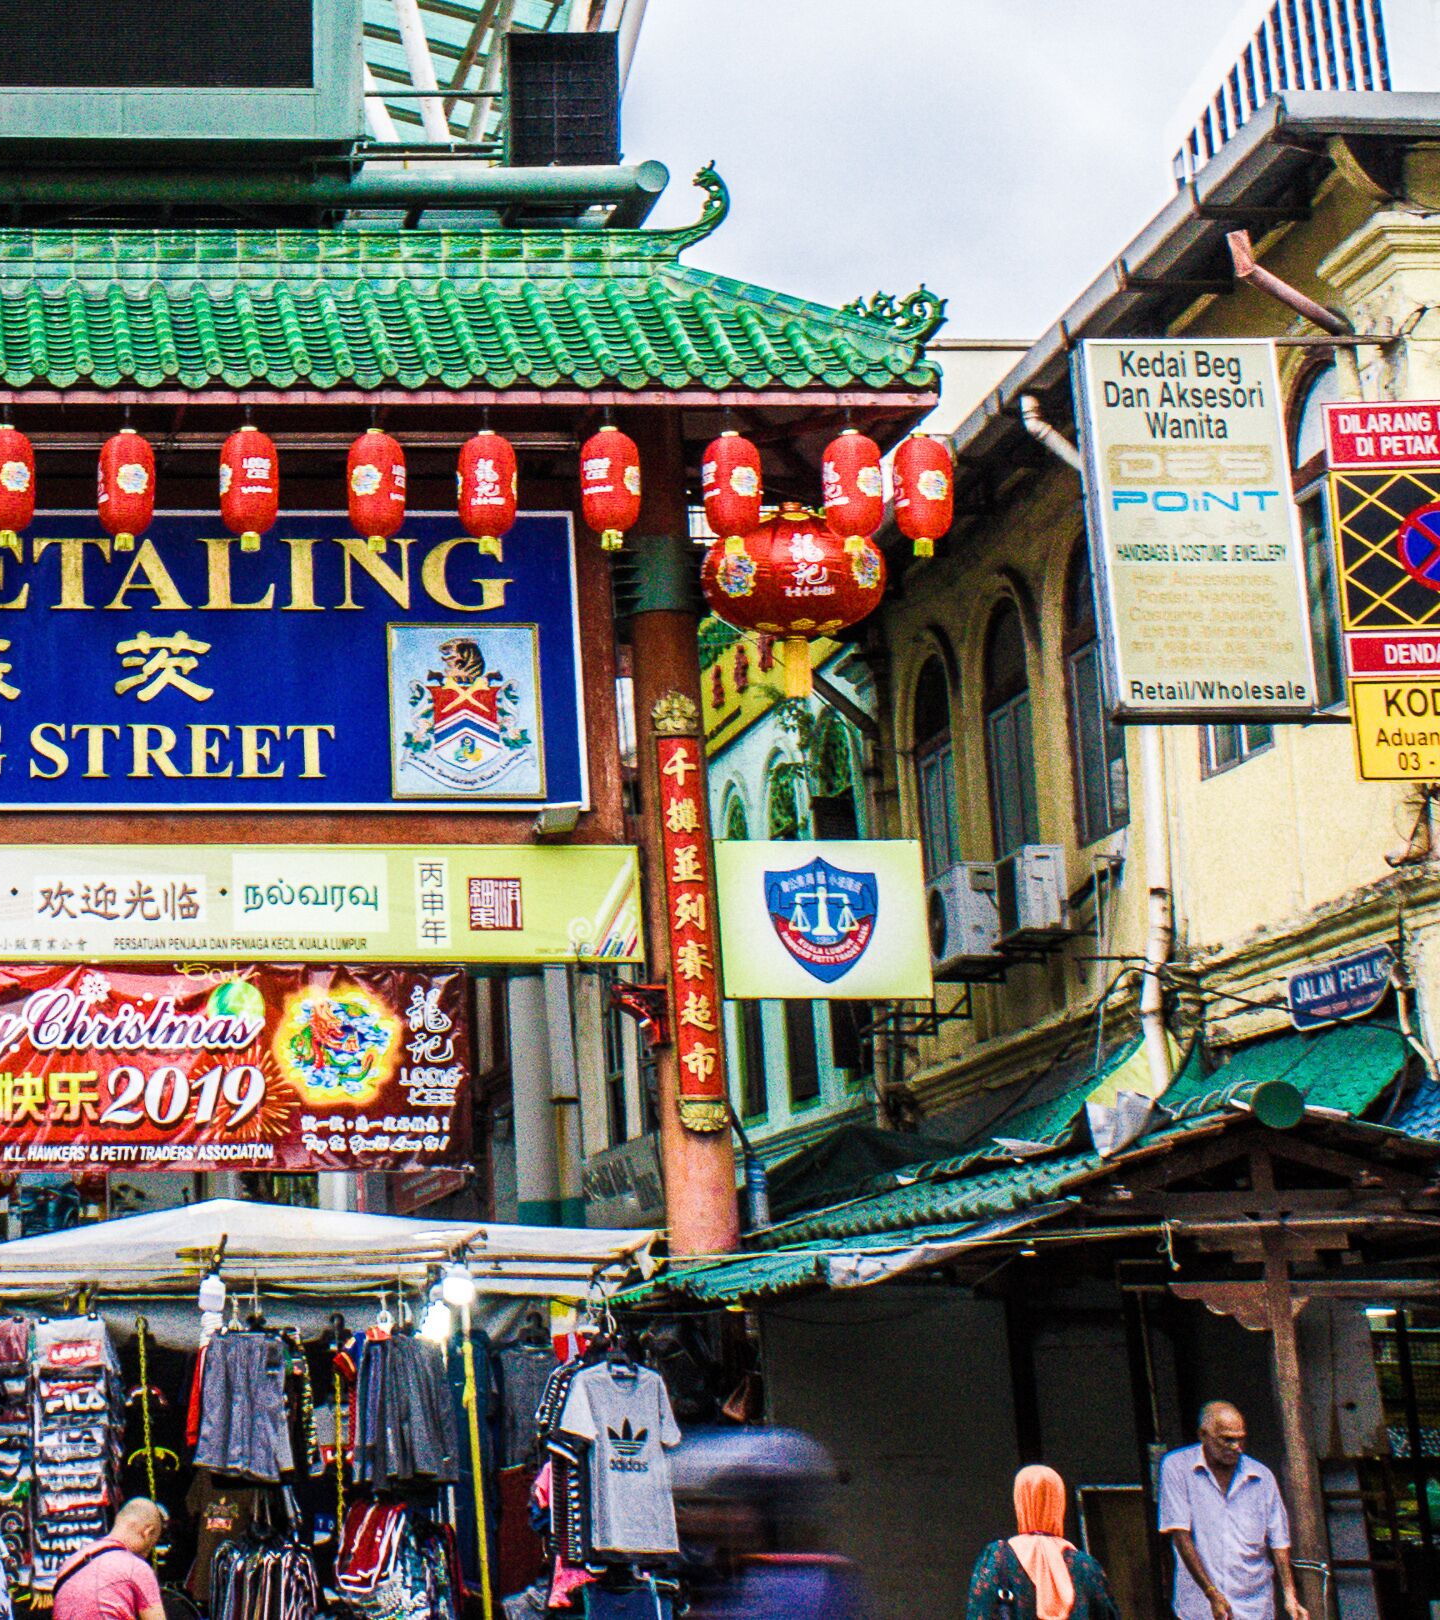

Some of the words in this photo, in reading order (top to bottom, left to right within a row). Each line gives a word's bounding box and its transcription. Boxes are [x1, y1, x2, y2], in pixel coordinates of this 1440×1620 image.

[1120, 350, 1187, 378] Kedai
[1195, 351, 1242, 384] Beg
[1103, 381, 1153, 408] Dan
[1159, 381, 1265, 409] Aksesori
[1145, 412, 1228, 440] Wanita
[1338, 412, 1432, 434] DILARANG
[1355, 437, 1374, 456] DI
[1380, 434, 1439, 456] PETAK
[1129, 680, 1306, 701] Retail/Wholesale
[29, 722, 335, 779] STREET
[1398, 752, 1420, 770] 03
[37, 880, 201, 921] 欢迎光临
[243, 878, 379, 914] நல்வரவு
[418, 862, 448, 945] 丙申年
[113, 937, 166, 950] PERSATUAN
[168, 937, 207, 950] PENJAJA
[210, 937, 227, 950] DAN
[230, 937, 269, 950] PENIAGA
[271, 937, 296, 950] KECIL
[299, 937, 328, 950] KUALA
[331, 937, 368, 950] LUMPUR
[23, 987, 266, 1051] Christmas
[100, 1065, 267, 1127] 2019
[89, 1145, 99, 1161] &
[100, 1145, 138, 1161] PETTY
[197, 1143, 274, 1160] ASSOCIATION
[45, 1392, 106, 1414] FILA
[609, 1456, 649, 1472] adidas
